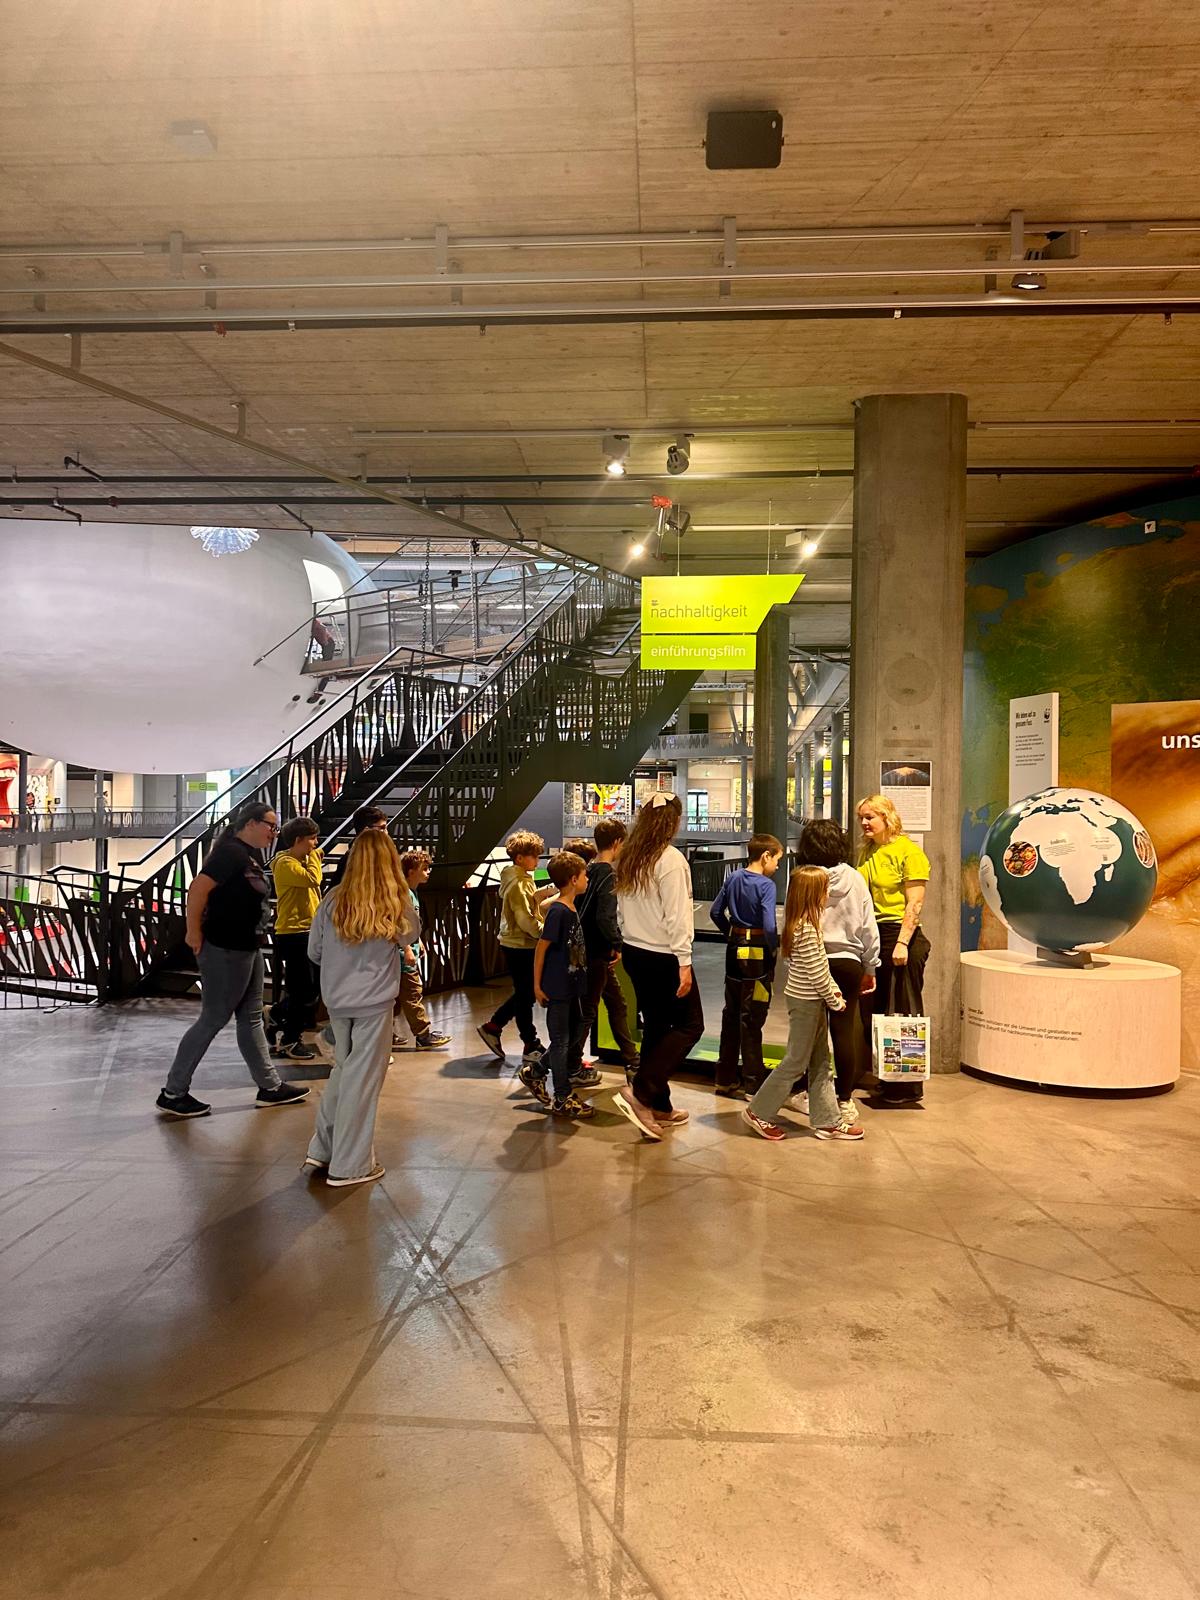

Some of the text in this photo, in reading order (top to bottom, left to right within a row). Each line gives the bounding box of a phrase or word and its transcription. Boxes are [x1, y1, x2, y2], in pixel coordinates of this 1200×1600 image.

[650, 604, 748, 621] nachhaltigkeit
[651, 645, 746, 660] einführungsfilm
[1161, 734, 1200, 749] uns
